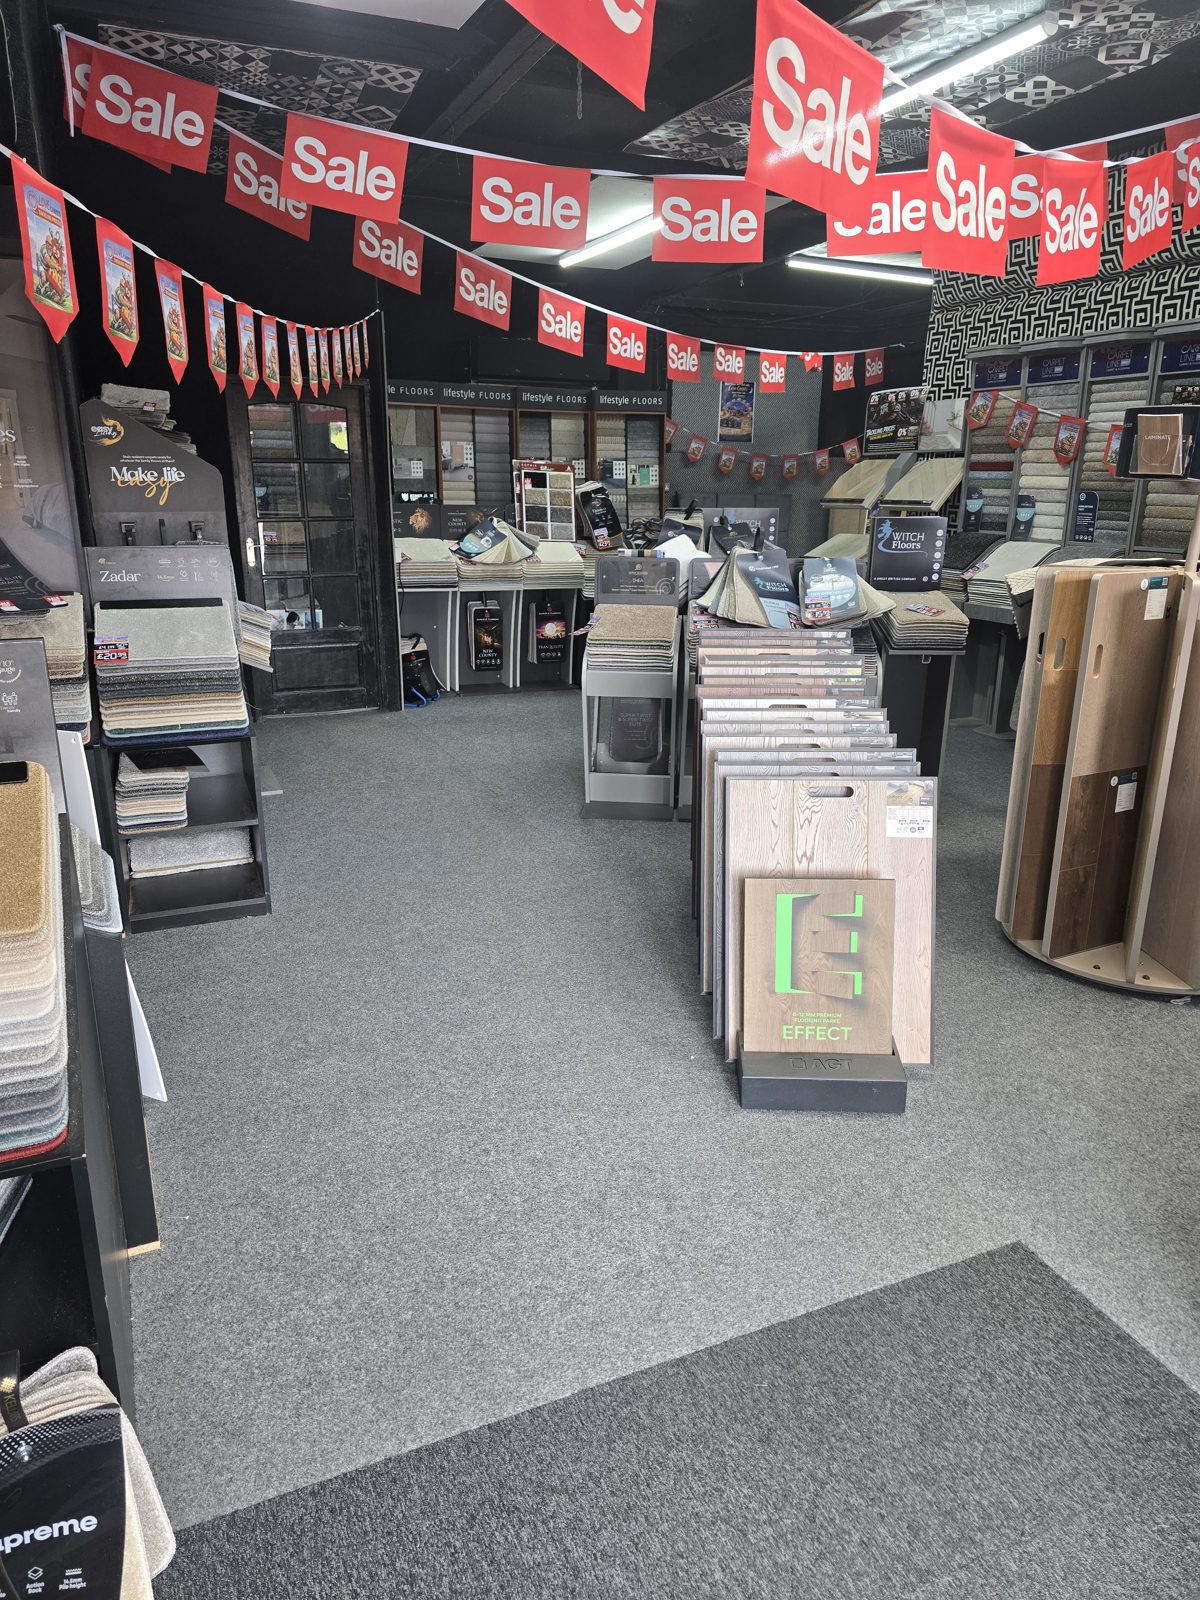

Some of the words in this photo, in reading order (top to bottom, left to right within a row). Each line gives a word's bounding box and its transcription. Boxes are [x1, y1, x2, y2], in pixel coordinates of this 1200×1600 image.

[96, 74, 205, 147] Sale
[762, 37, 872, 186] Sale
[291, 136, 396, 201] Sale
[479, 176, 581, 230] Sale
[931, 151, 1007, 242] Sale
[1126, 176, 1169, 243] Sale
[660, 196, 758, 243] Sale
[1045, 187, 1099, 255] Sale
[359, 219, 418, 277] Sale
[459, 267, 508, 315] Sale
[541, 302, 582, 343] Sale
[609, 327, 644, 362] Sale
[668, 343, 699, 372] Sale
[716, 347, 743, 374] Sale
[761, 360, 785, 383] Sale
[834, 362, 854, 382] Sale
[866, 356, 883, 378] Sale
[400, 386, 434, 396] FLOORS
[443, 388, 476, 400] lifestyle
[479, 391, 511, 401] FLOORS
[522, 392, 553, 403] lifestyle
[556, 395, 587, 404] FLOORS
[600, 395, 629, 406] lifestyle
[632, 396, 663, 405] FLOORS
[110, 466, 158, 482] Make
[163, 466, 186, 482] life
[117, 476, 177, 506] easy
[891, 540, 921, 549] Floors
[892, 531, 925, 541] WITCH
[100, 570, 142, 583] Zadar
[782, 1025, 853, 1041] EFFECT
[69, 1582, 87, 1590] height
